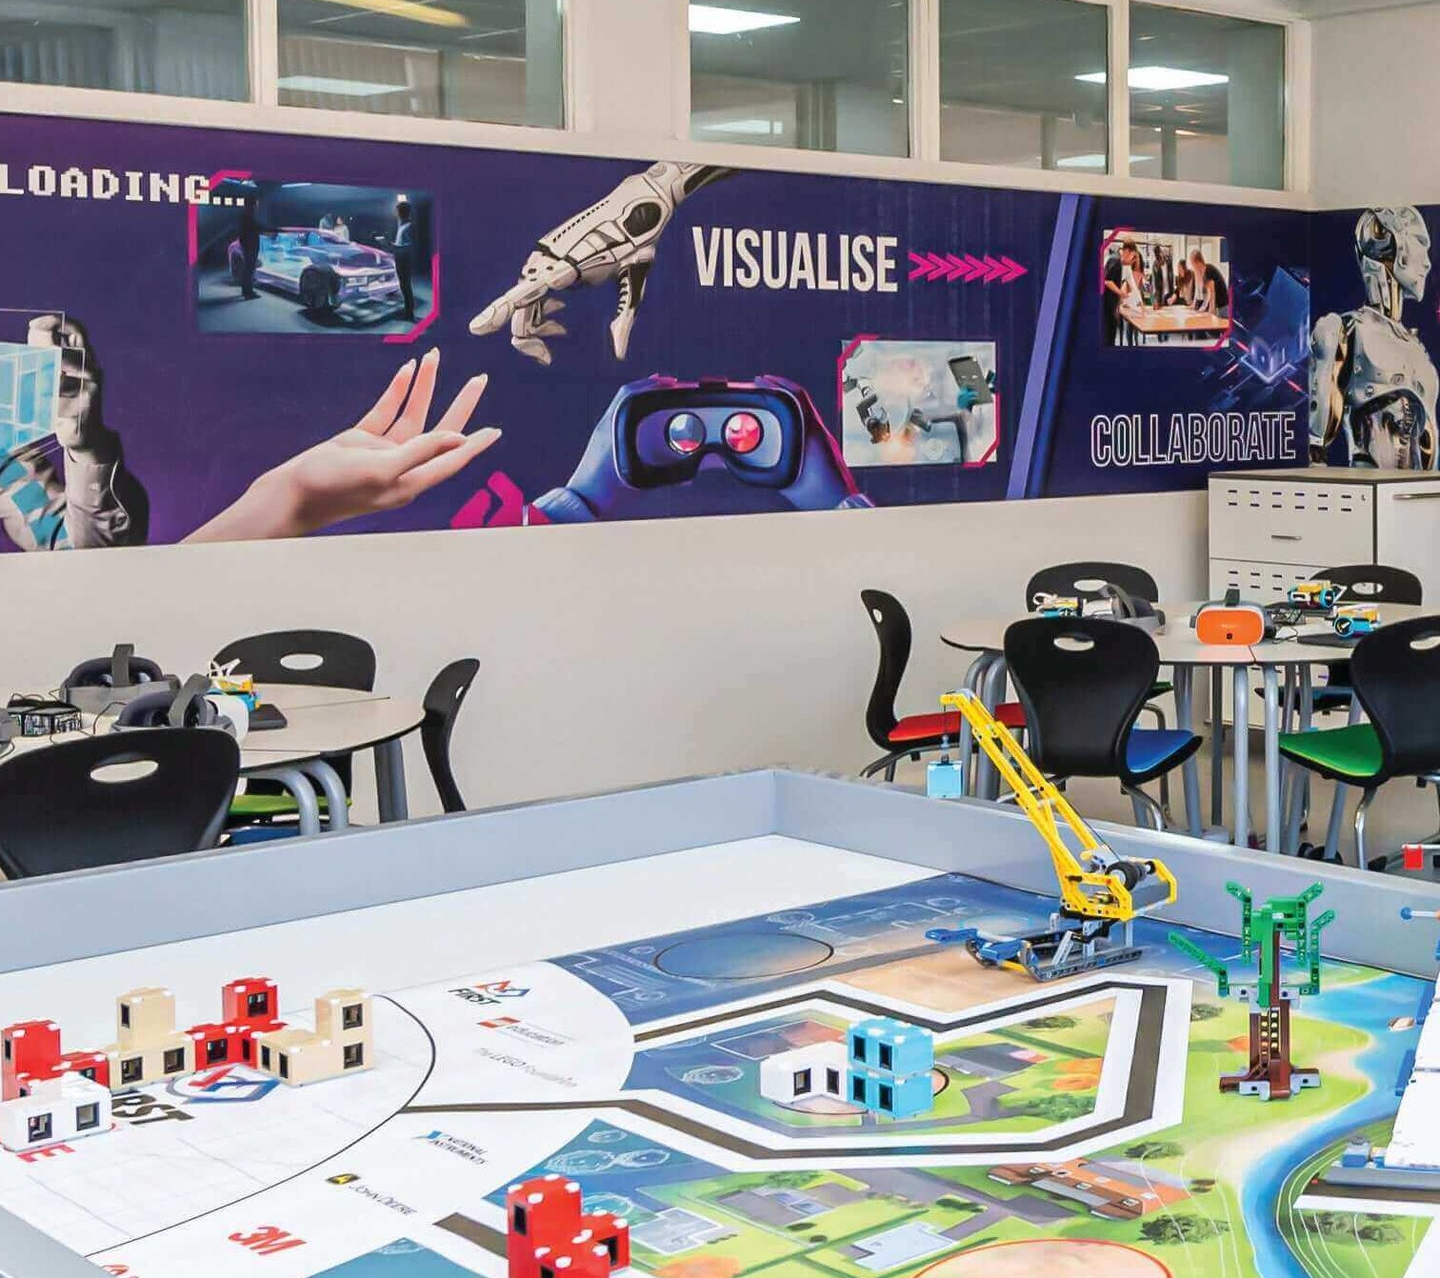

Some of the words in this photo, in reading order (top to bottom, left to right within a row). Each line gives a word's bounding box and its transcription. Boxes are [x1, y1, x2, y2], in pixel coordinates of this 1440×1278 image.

[692, 226, 898, 292] VISUALISE
[1090, 410, 1297, 468] COLLABORATE
[447, 988, 502, 1005] FIRST
[228, 1226, 307, 1256] 3M
